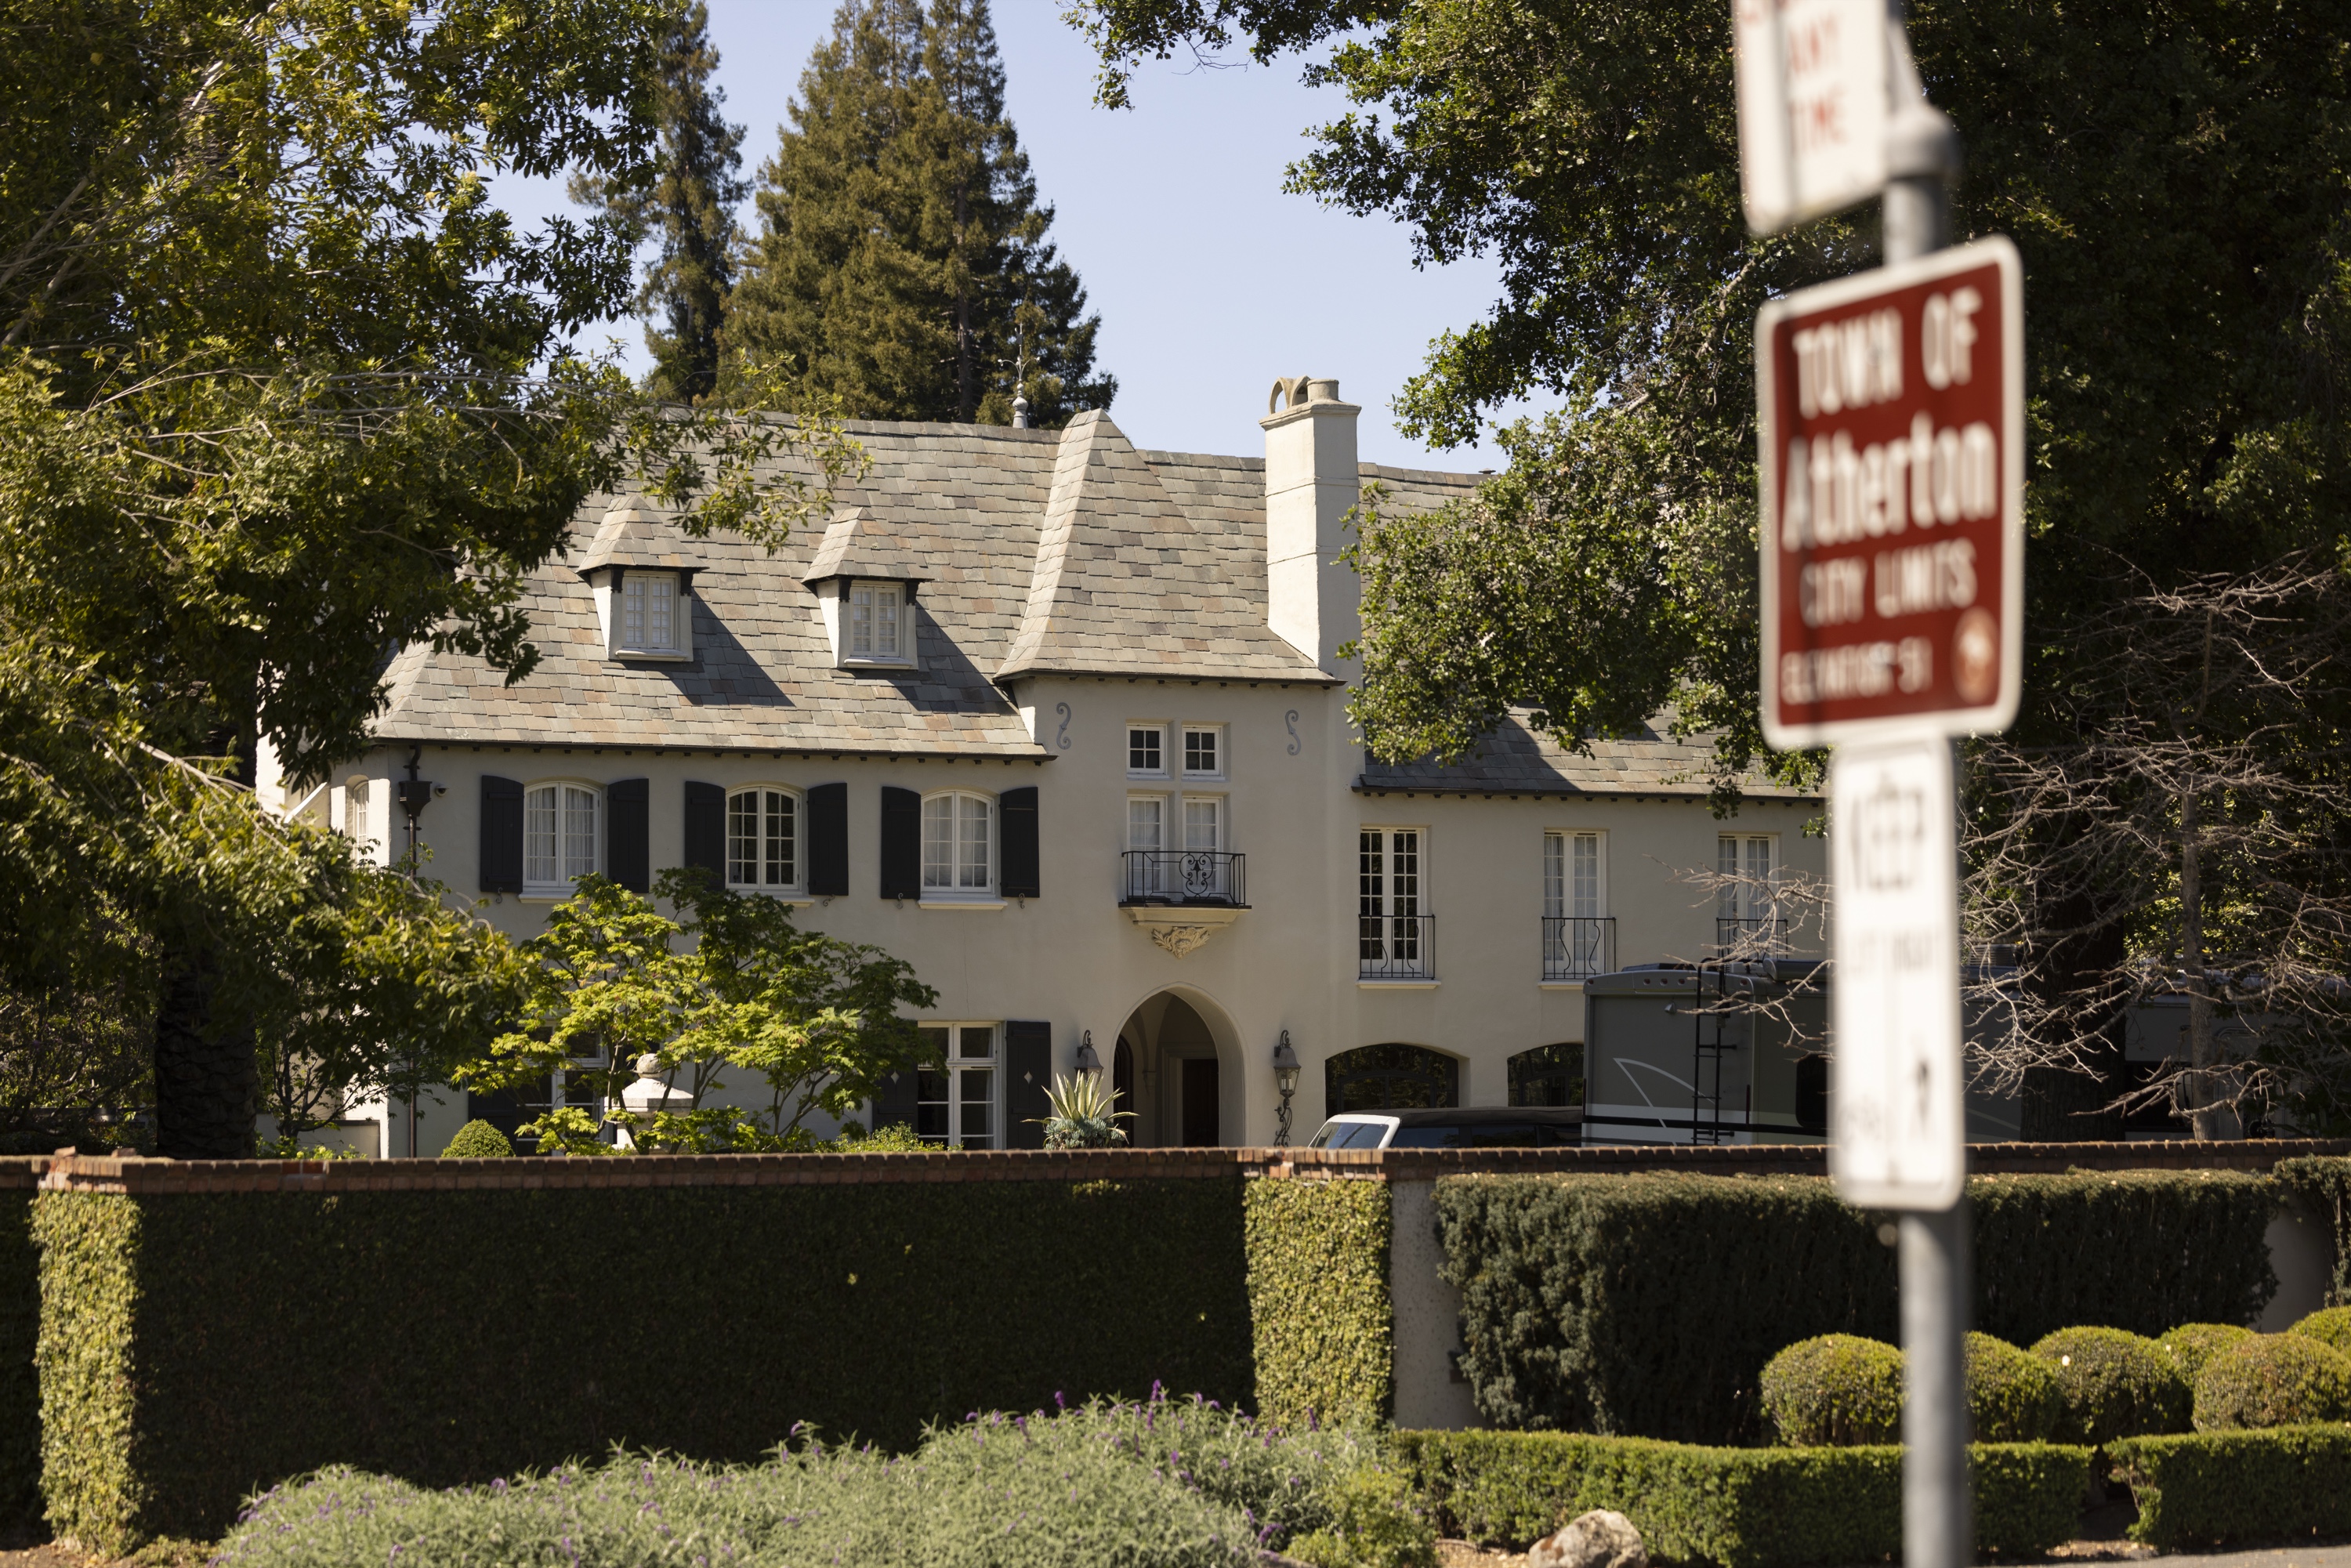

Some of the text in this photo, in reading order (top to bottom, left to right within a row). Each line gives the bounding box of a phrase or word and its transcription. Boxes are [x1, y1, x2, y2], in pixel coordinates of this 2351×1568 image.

[1793, 284, 1983, 418] TOWN OF
[1782, 410, 1998, 552] Atherton
[1800, 538, 1977, 626] CITY LIMITS
